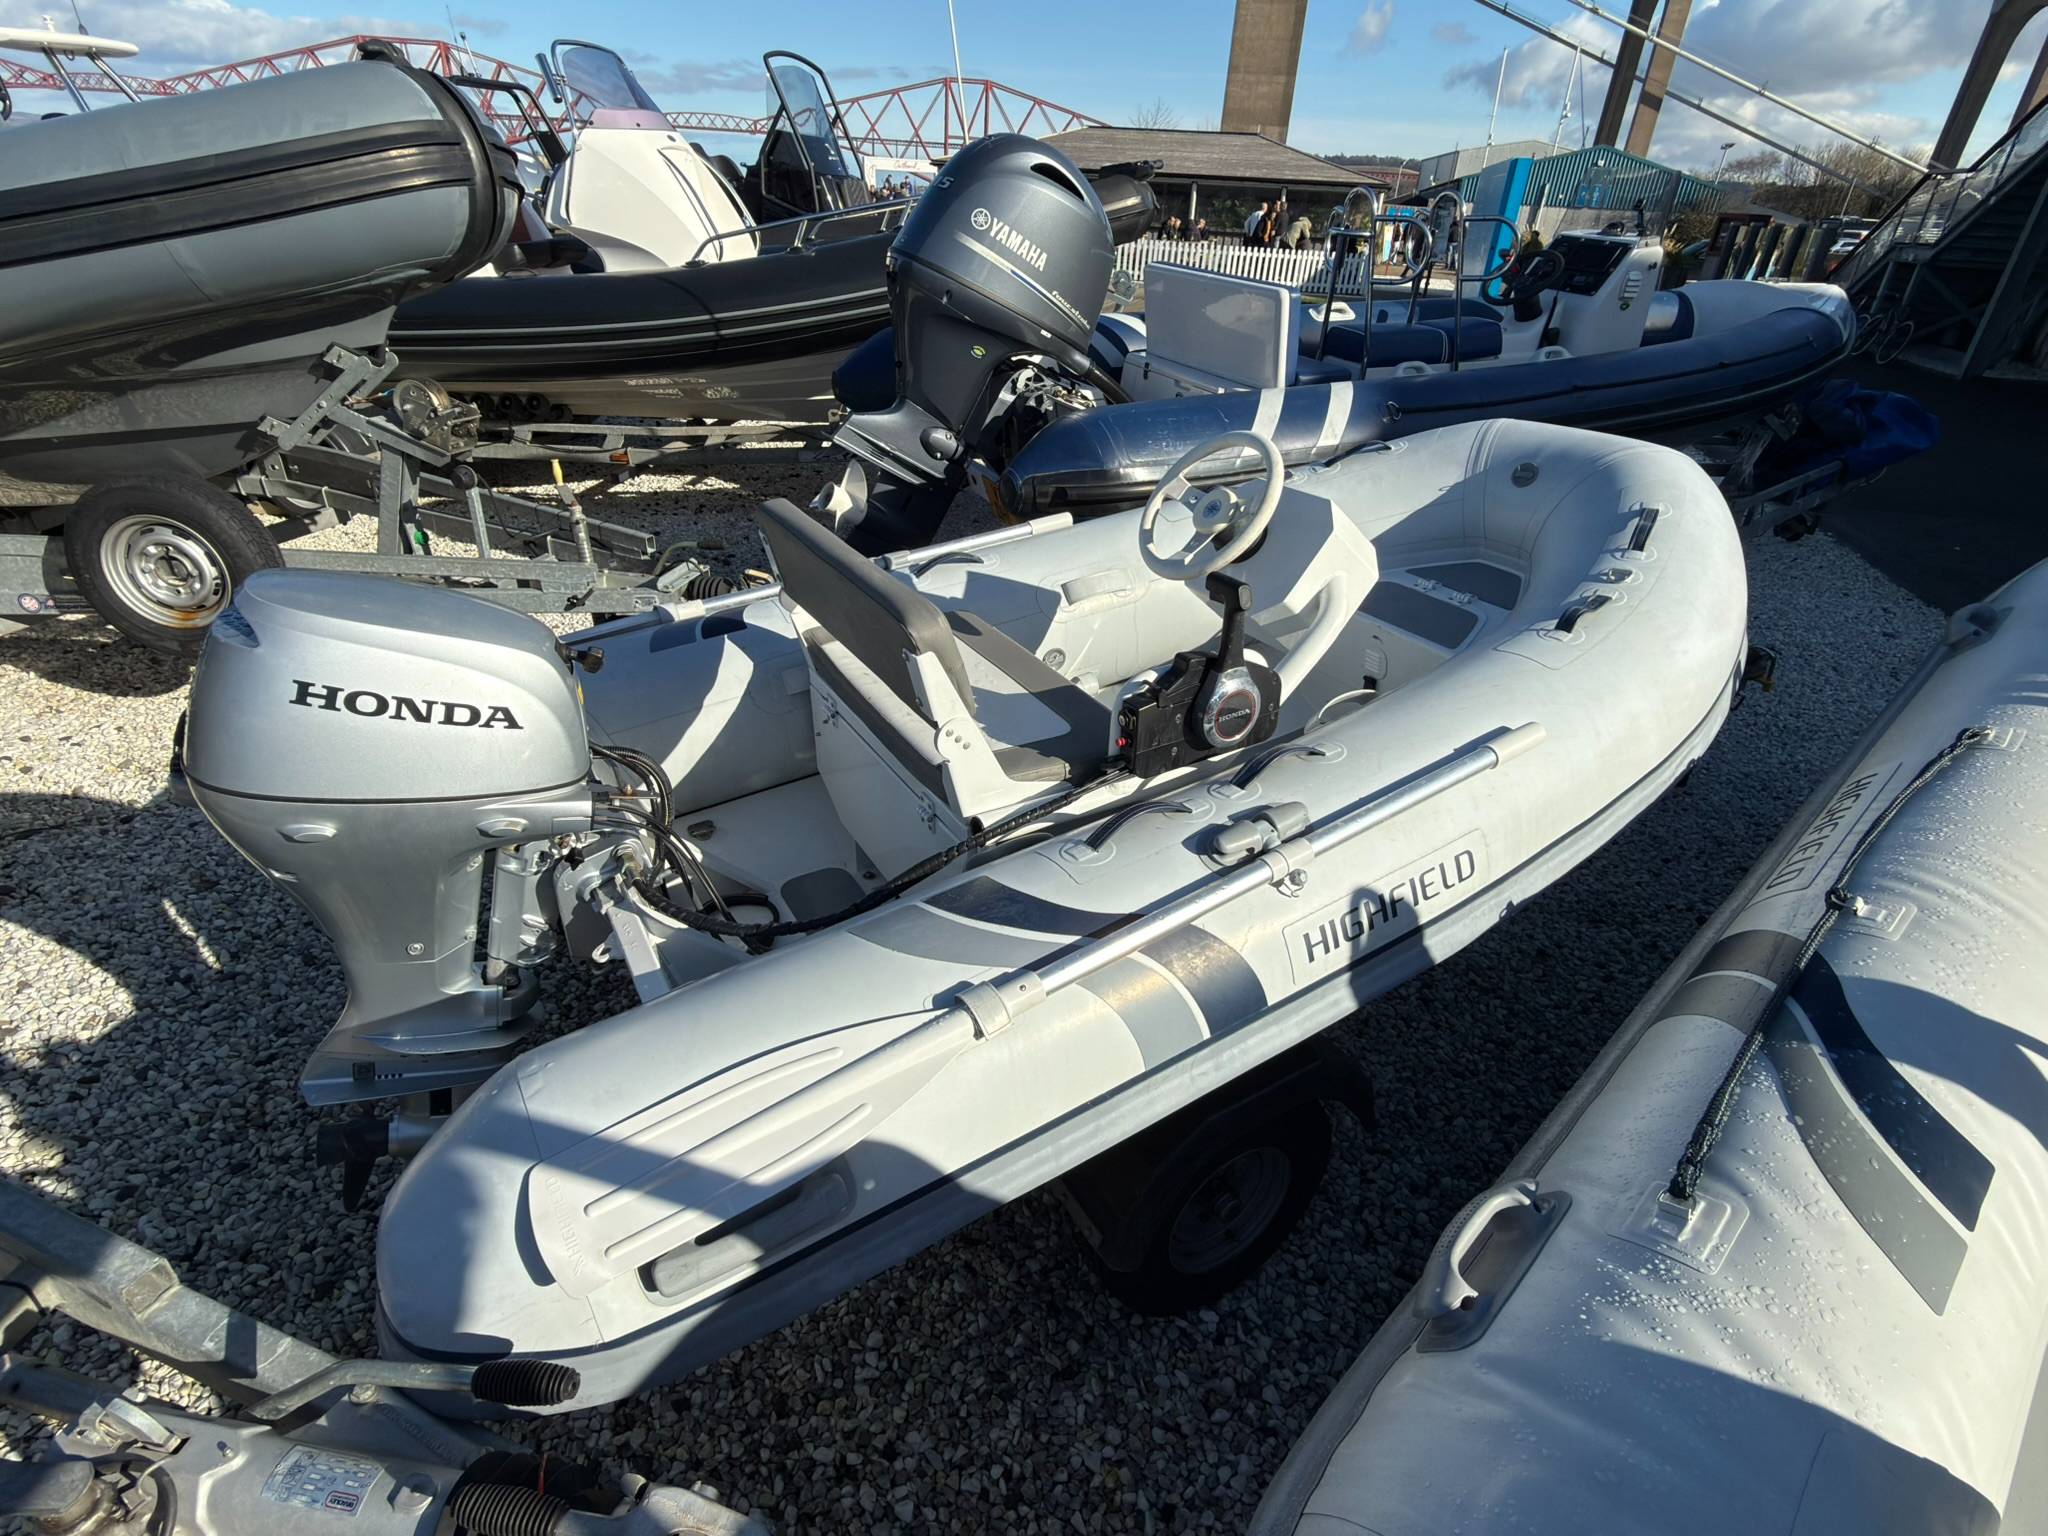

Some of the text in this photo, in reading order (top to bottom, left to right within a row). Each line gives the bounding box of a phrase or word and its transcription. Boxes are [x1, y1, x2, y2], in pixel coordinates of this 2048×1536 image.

[989, 217, 1048, 272] YAMAHA
[288, 679, 524, 730] HONDA
[1218, 708, 1251, 722] HONDA
[1766, 772, 1879, 890] HIGHFIELD
[1302, 849, 1476, 964] HIGHFIELD
